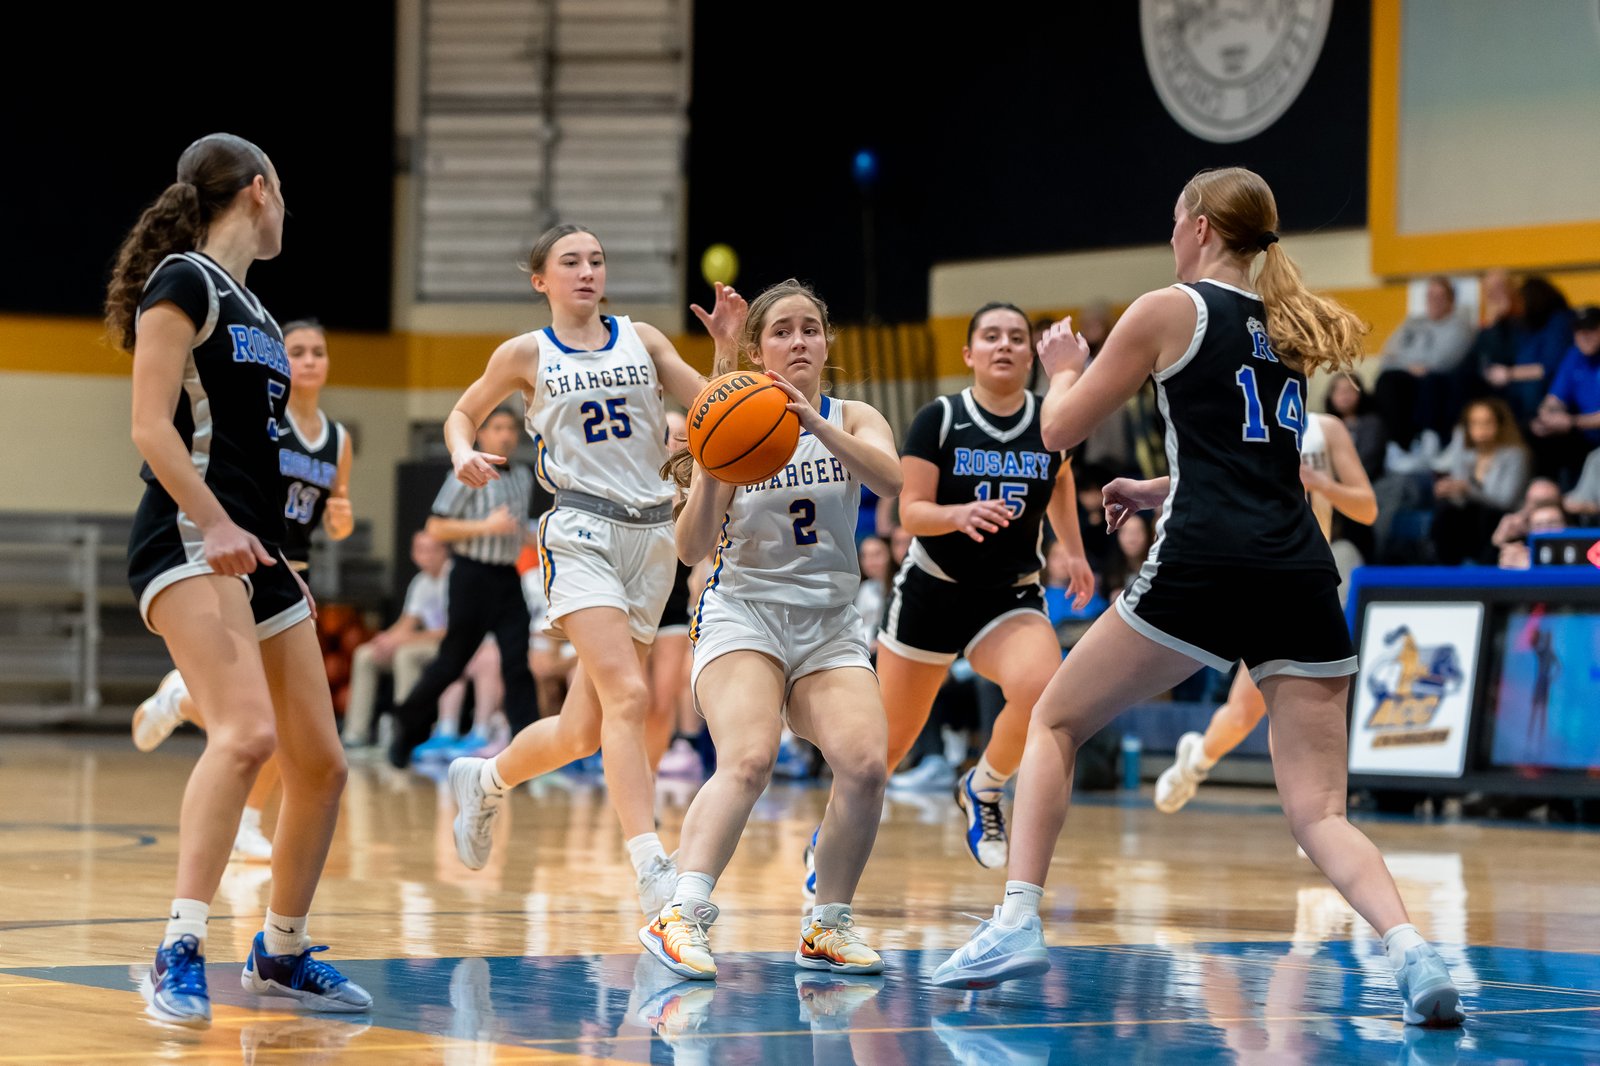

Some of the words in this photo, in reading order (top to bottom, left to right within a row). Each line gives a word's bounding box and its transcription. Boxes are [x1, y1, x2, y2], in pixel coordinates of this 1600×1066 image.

[545, 365, 649, 398] CHARGERS
[692, 375, 758, 430] Wilson
[580, 397, 632, 444] 25
[1235, 364, 1308, 456] 14
[745, 457, 852, 493] ARGER
[953, 447, 1051, 480] ROSARY
[789, 498, 818, 546] 2
[974, 481, 1029, 520] 15
